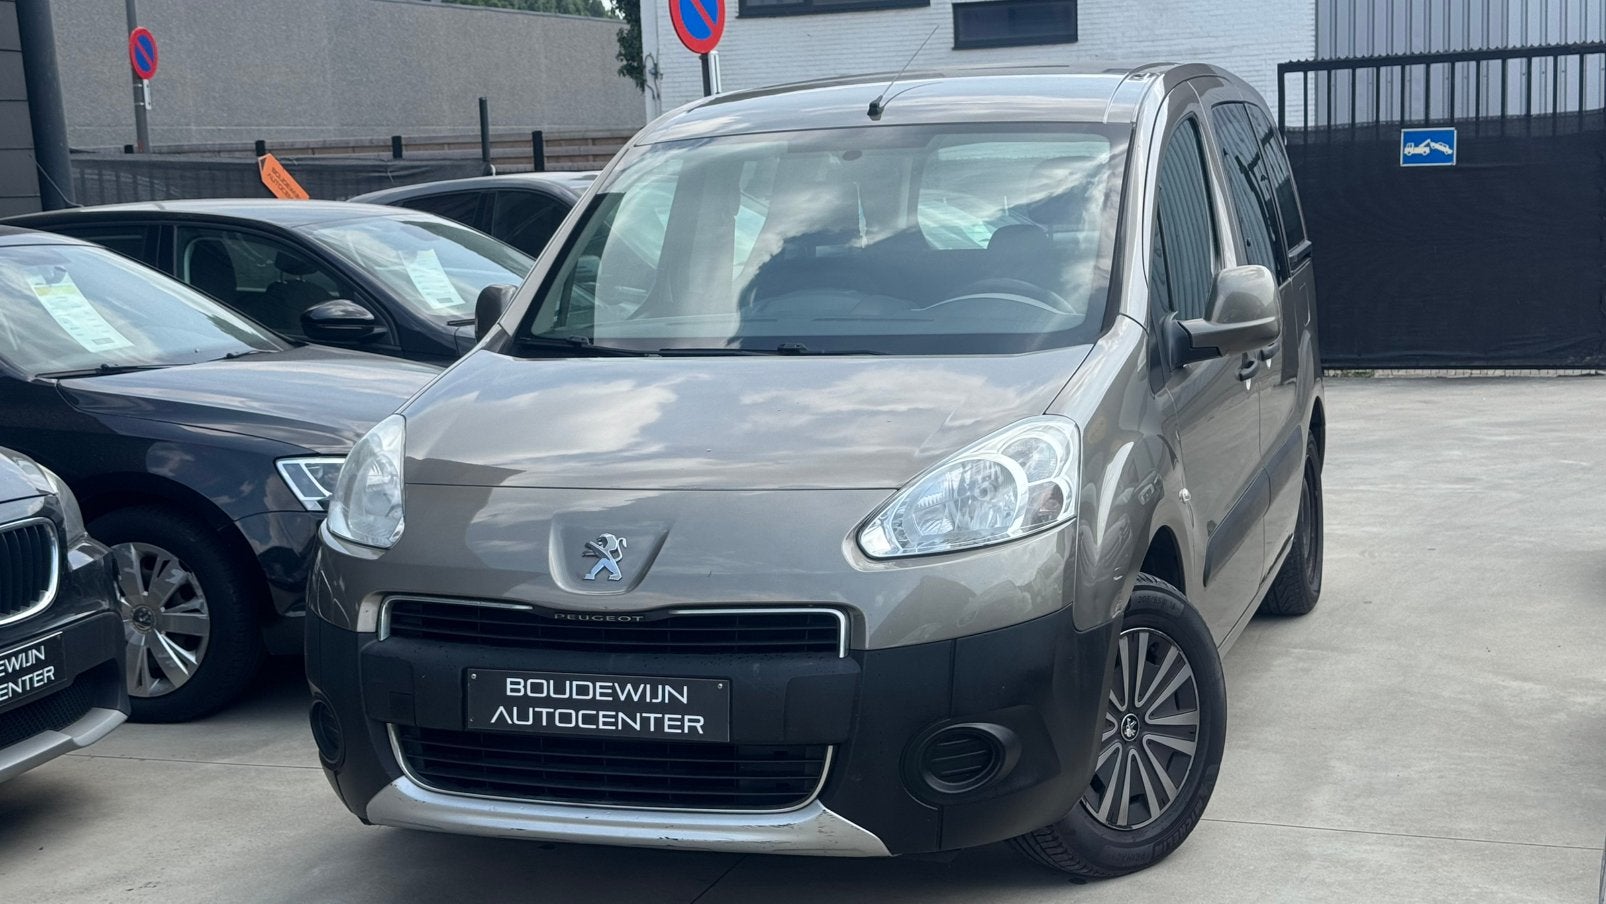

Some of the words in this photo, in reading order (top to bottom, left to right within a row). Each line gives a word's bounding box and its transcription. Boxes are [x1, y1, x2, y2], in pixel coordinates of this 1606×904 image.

[554, 613, 645, 622] PEUGEOT
[506, 677, 688, 704] BOUDEWIJN
[490, 705, 705, 734] AUTOCENTER
